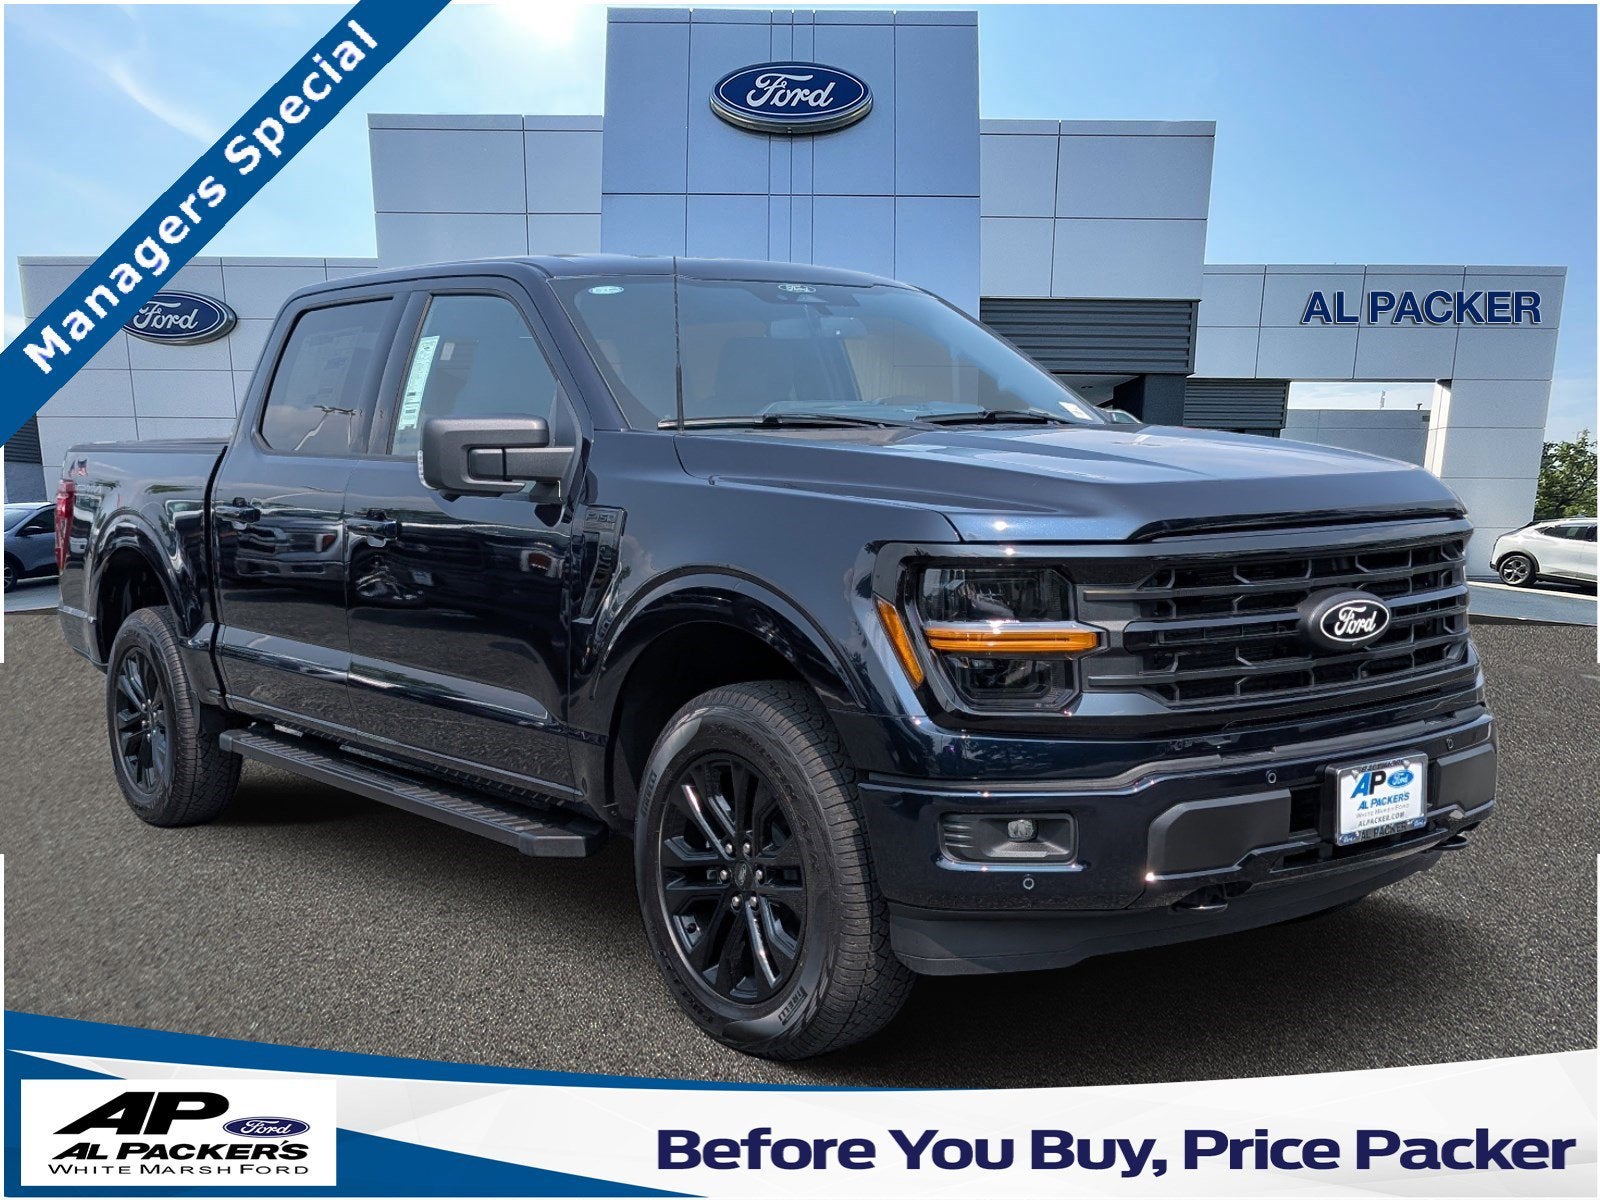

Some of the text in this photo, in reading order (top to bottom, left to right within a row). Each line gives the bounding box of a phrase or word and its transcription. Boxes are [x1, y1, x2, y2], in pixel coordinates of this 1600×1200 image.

[746, 73, 836, 108] Ford
[133, 301, 199, 329] Ford
[1301, 290, 1543, 325] AL PACKER
[1334, 606, 1377, 636] Ford
[1350, 770, 1387, 798] AP
[1357, 801, 1369, 811] AL
[1373, 820, 1407, 838] PACKER
